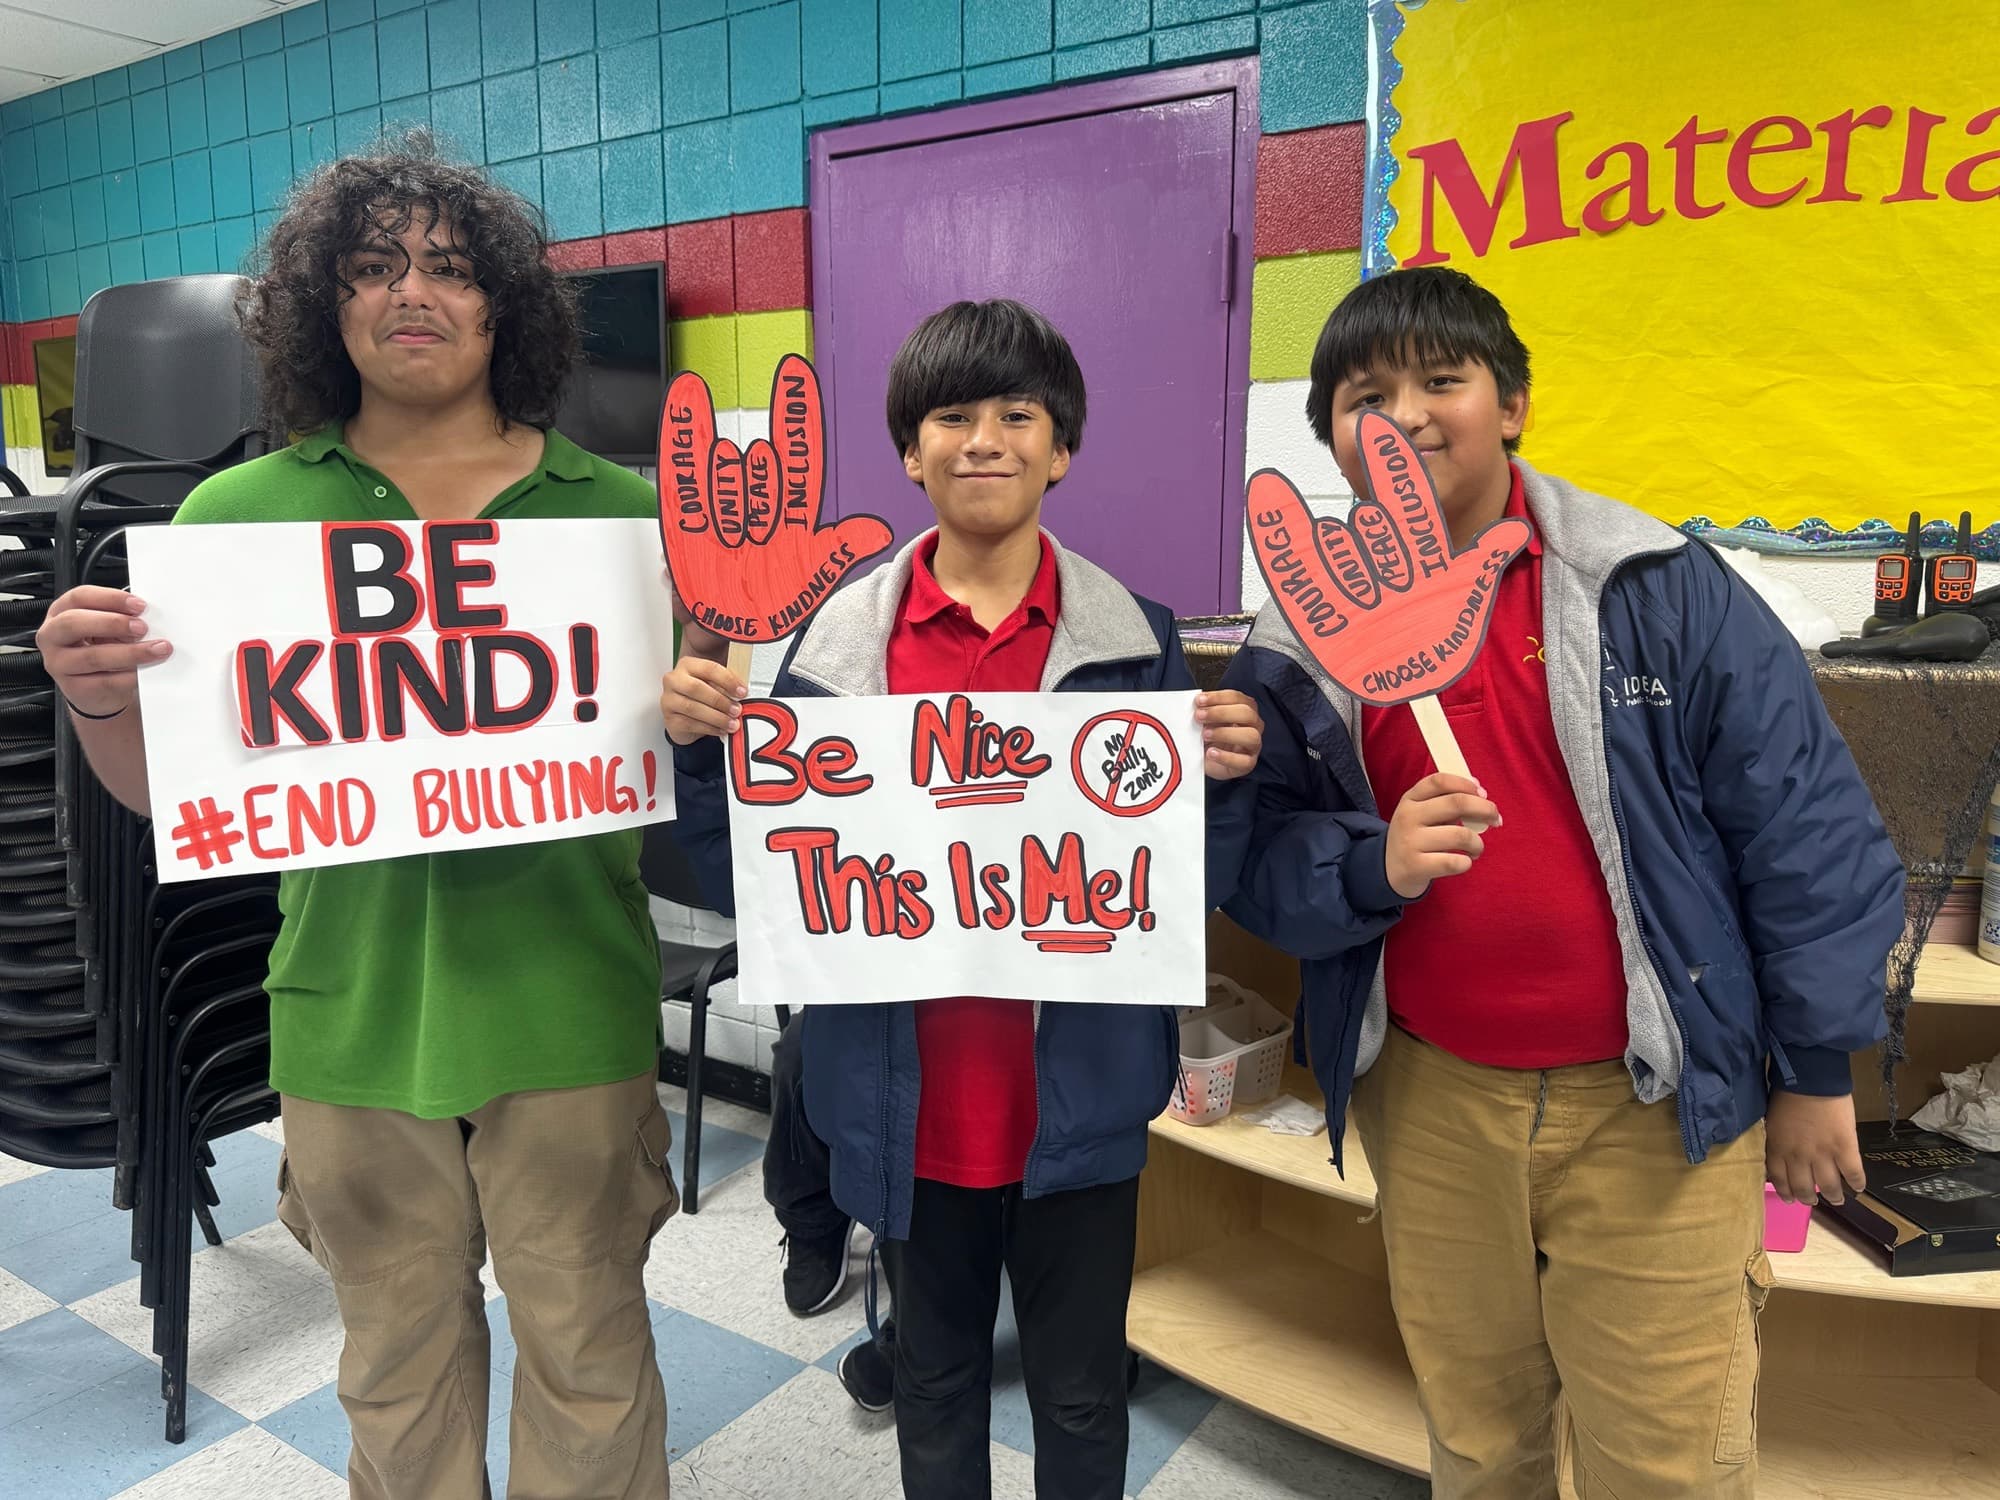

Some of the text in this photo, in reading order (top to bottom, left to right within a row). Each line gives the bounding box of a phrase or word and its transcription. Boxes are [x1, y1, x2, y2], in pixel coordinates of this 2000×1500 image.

[669, 402, 709, 535] COURAGE
[716, 453, 742, 535] UNITY
[747, 454, 769, 529] PEACE
[782, 375, 811, 533] INCLUSION
[1372, 433, 1449, 580] INCLUSION
[321, 519, 508, 637] BE
[691, 541, 857, 638] CHOOSE KINDNESS
[1256, 508, 1350, 638] COURAGE
[1321, 520, 1373, 599] UNITY
[1358, 509, 1406, 582] PEACE
[1362, 547, 1512, 695] CHOOSE KINDNESS
[236, 622, 599, 748] KIND!
[1623, 675, 1669, 696] IDEA
[727, 694, 1052, 807] Be Nice
[1101, 745, 1152, 785] Bully
[171, 749, 658, 870] #END BULLYING!
[765, 827, 1156, 940] This Is Me!
